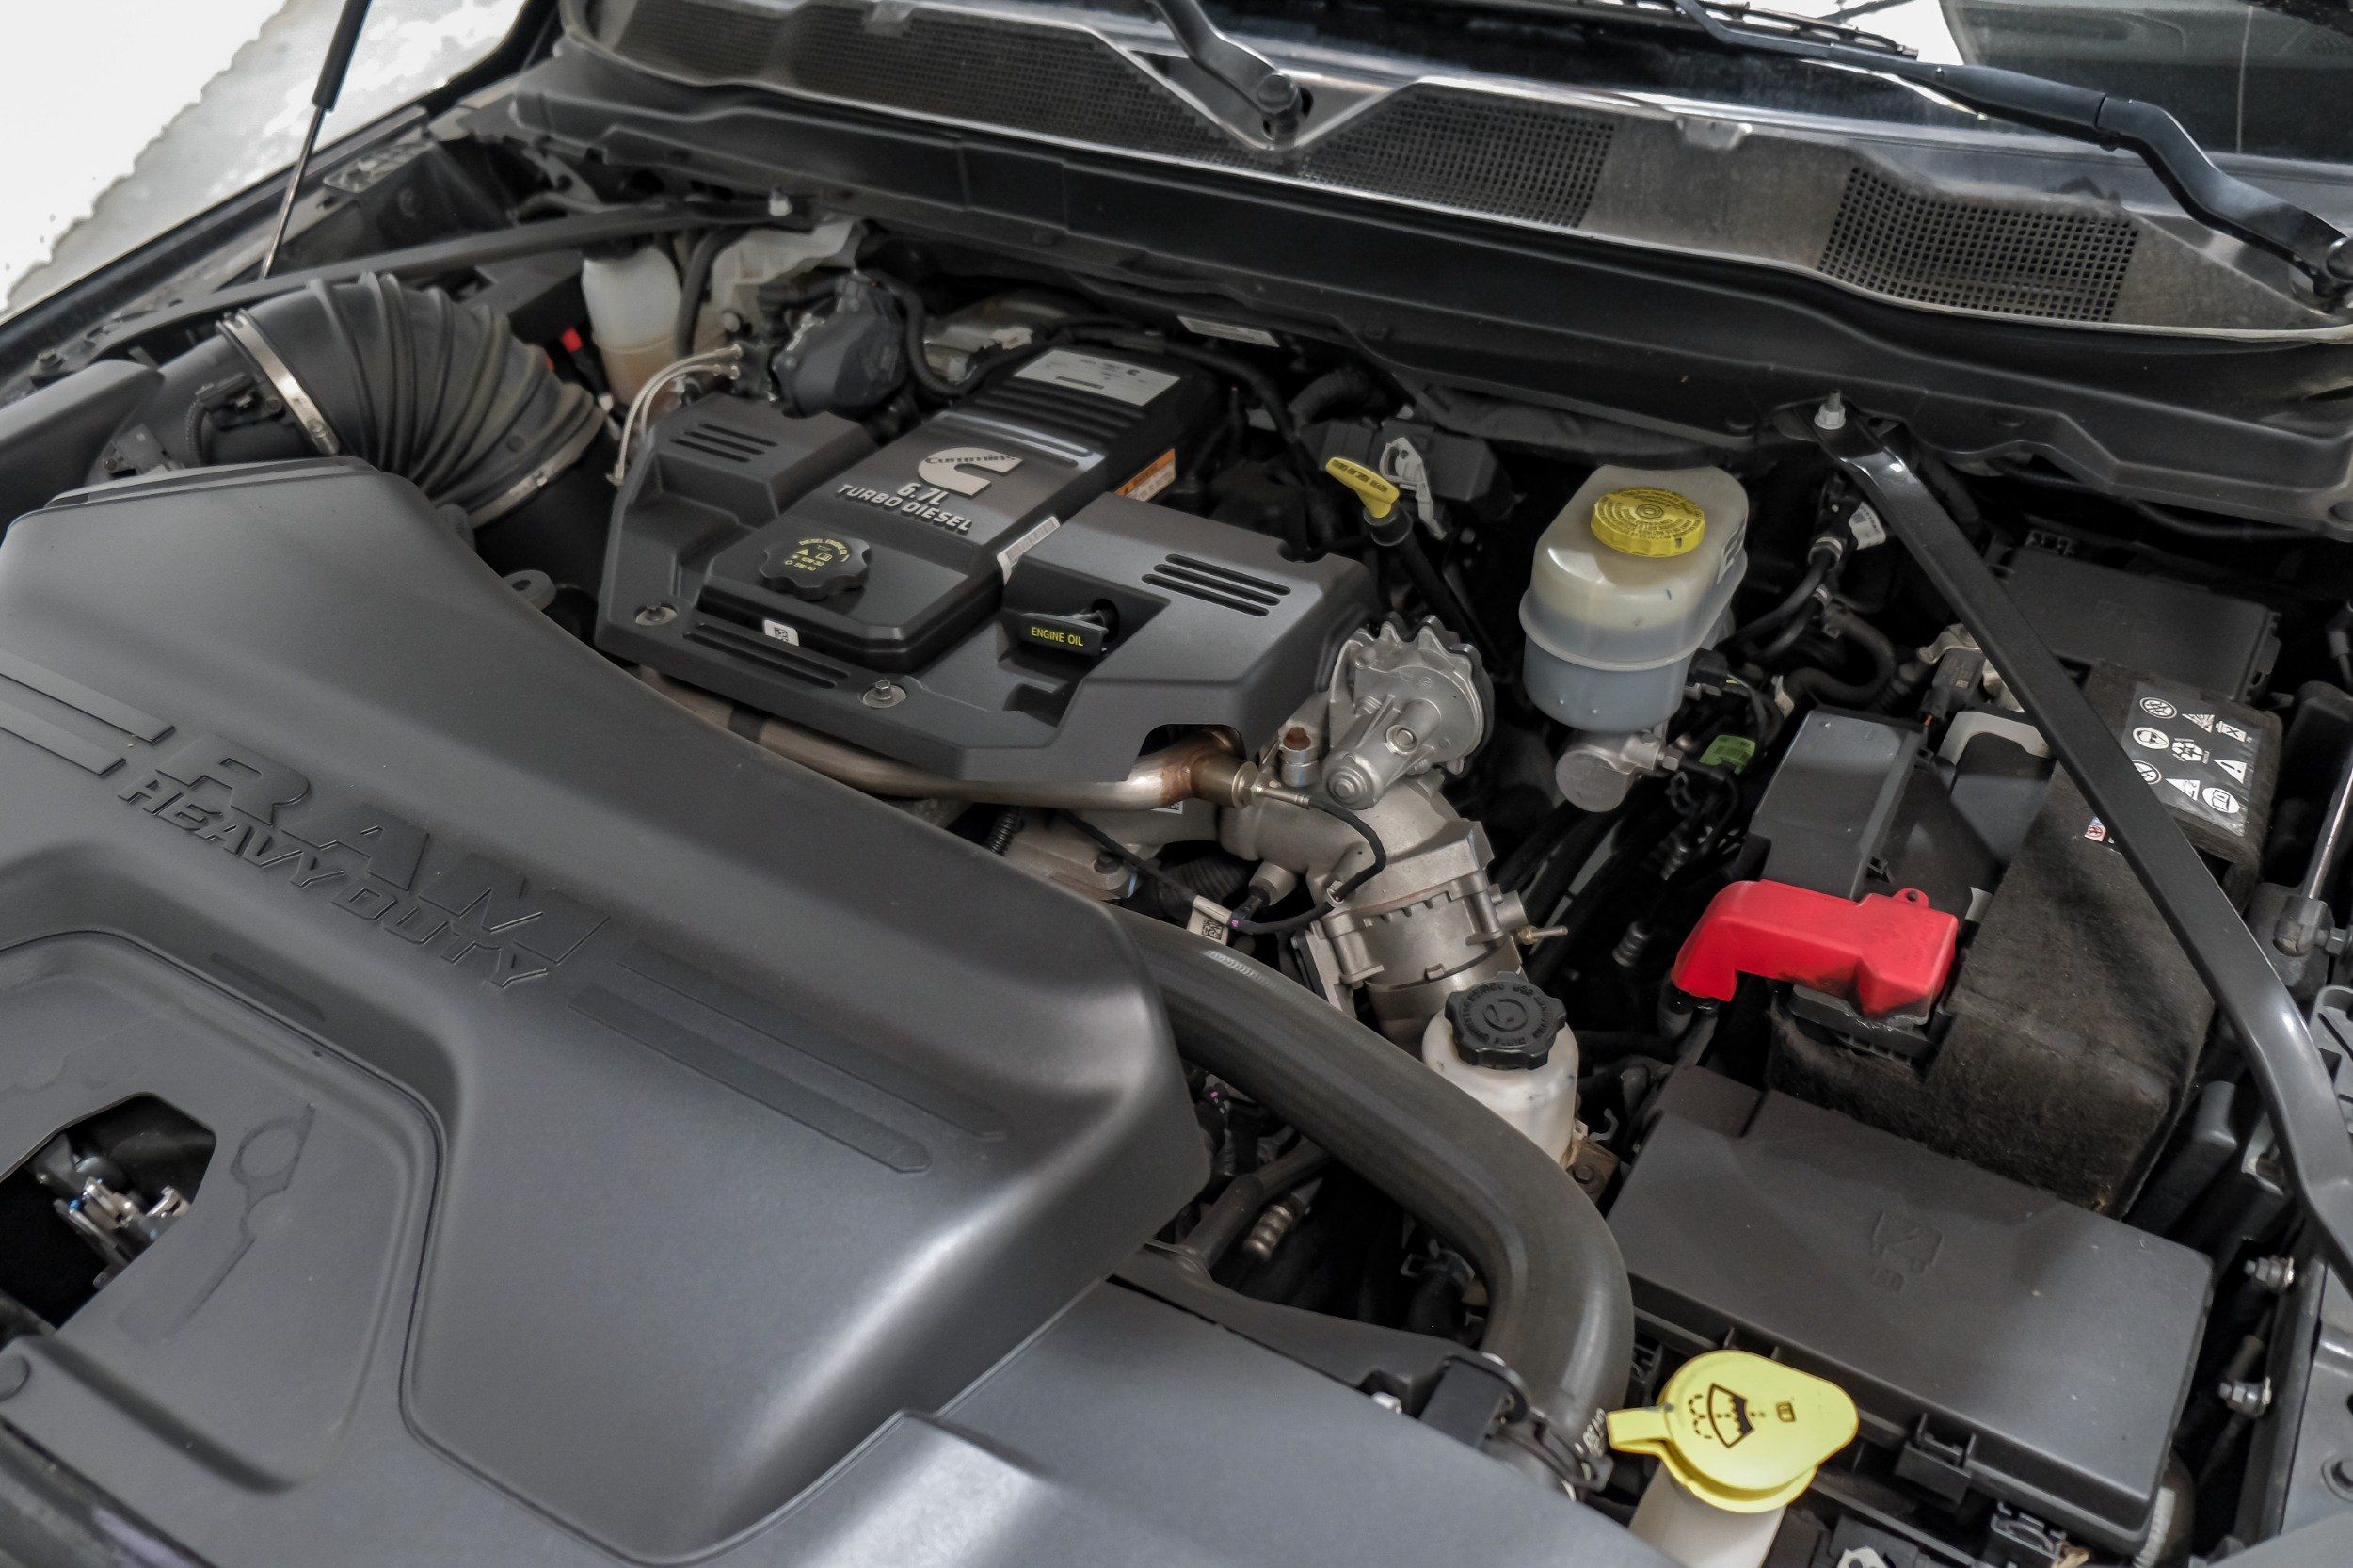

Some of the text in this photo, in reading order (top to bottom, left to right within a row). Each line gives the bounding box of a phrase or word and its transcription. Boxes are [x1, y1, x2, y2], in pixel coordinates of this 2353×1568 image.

[837, 483, 973, 534] TURBO DIESEL
[896, 482, 949, 506] 6.7L
[1031, 626, 1084, 647] ENGINE OIL
[155, 730, 611, 965] RAM
[118, 770, 550, 989] HEAVY DUTY
